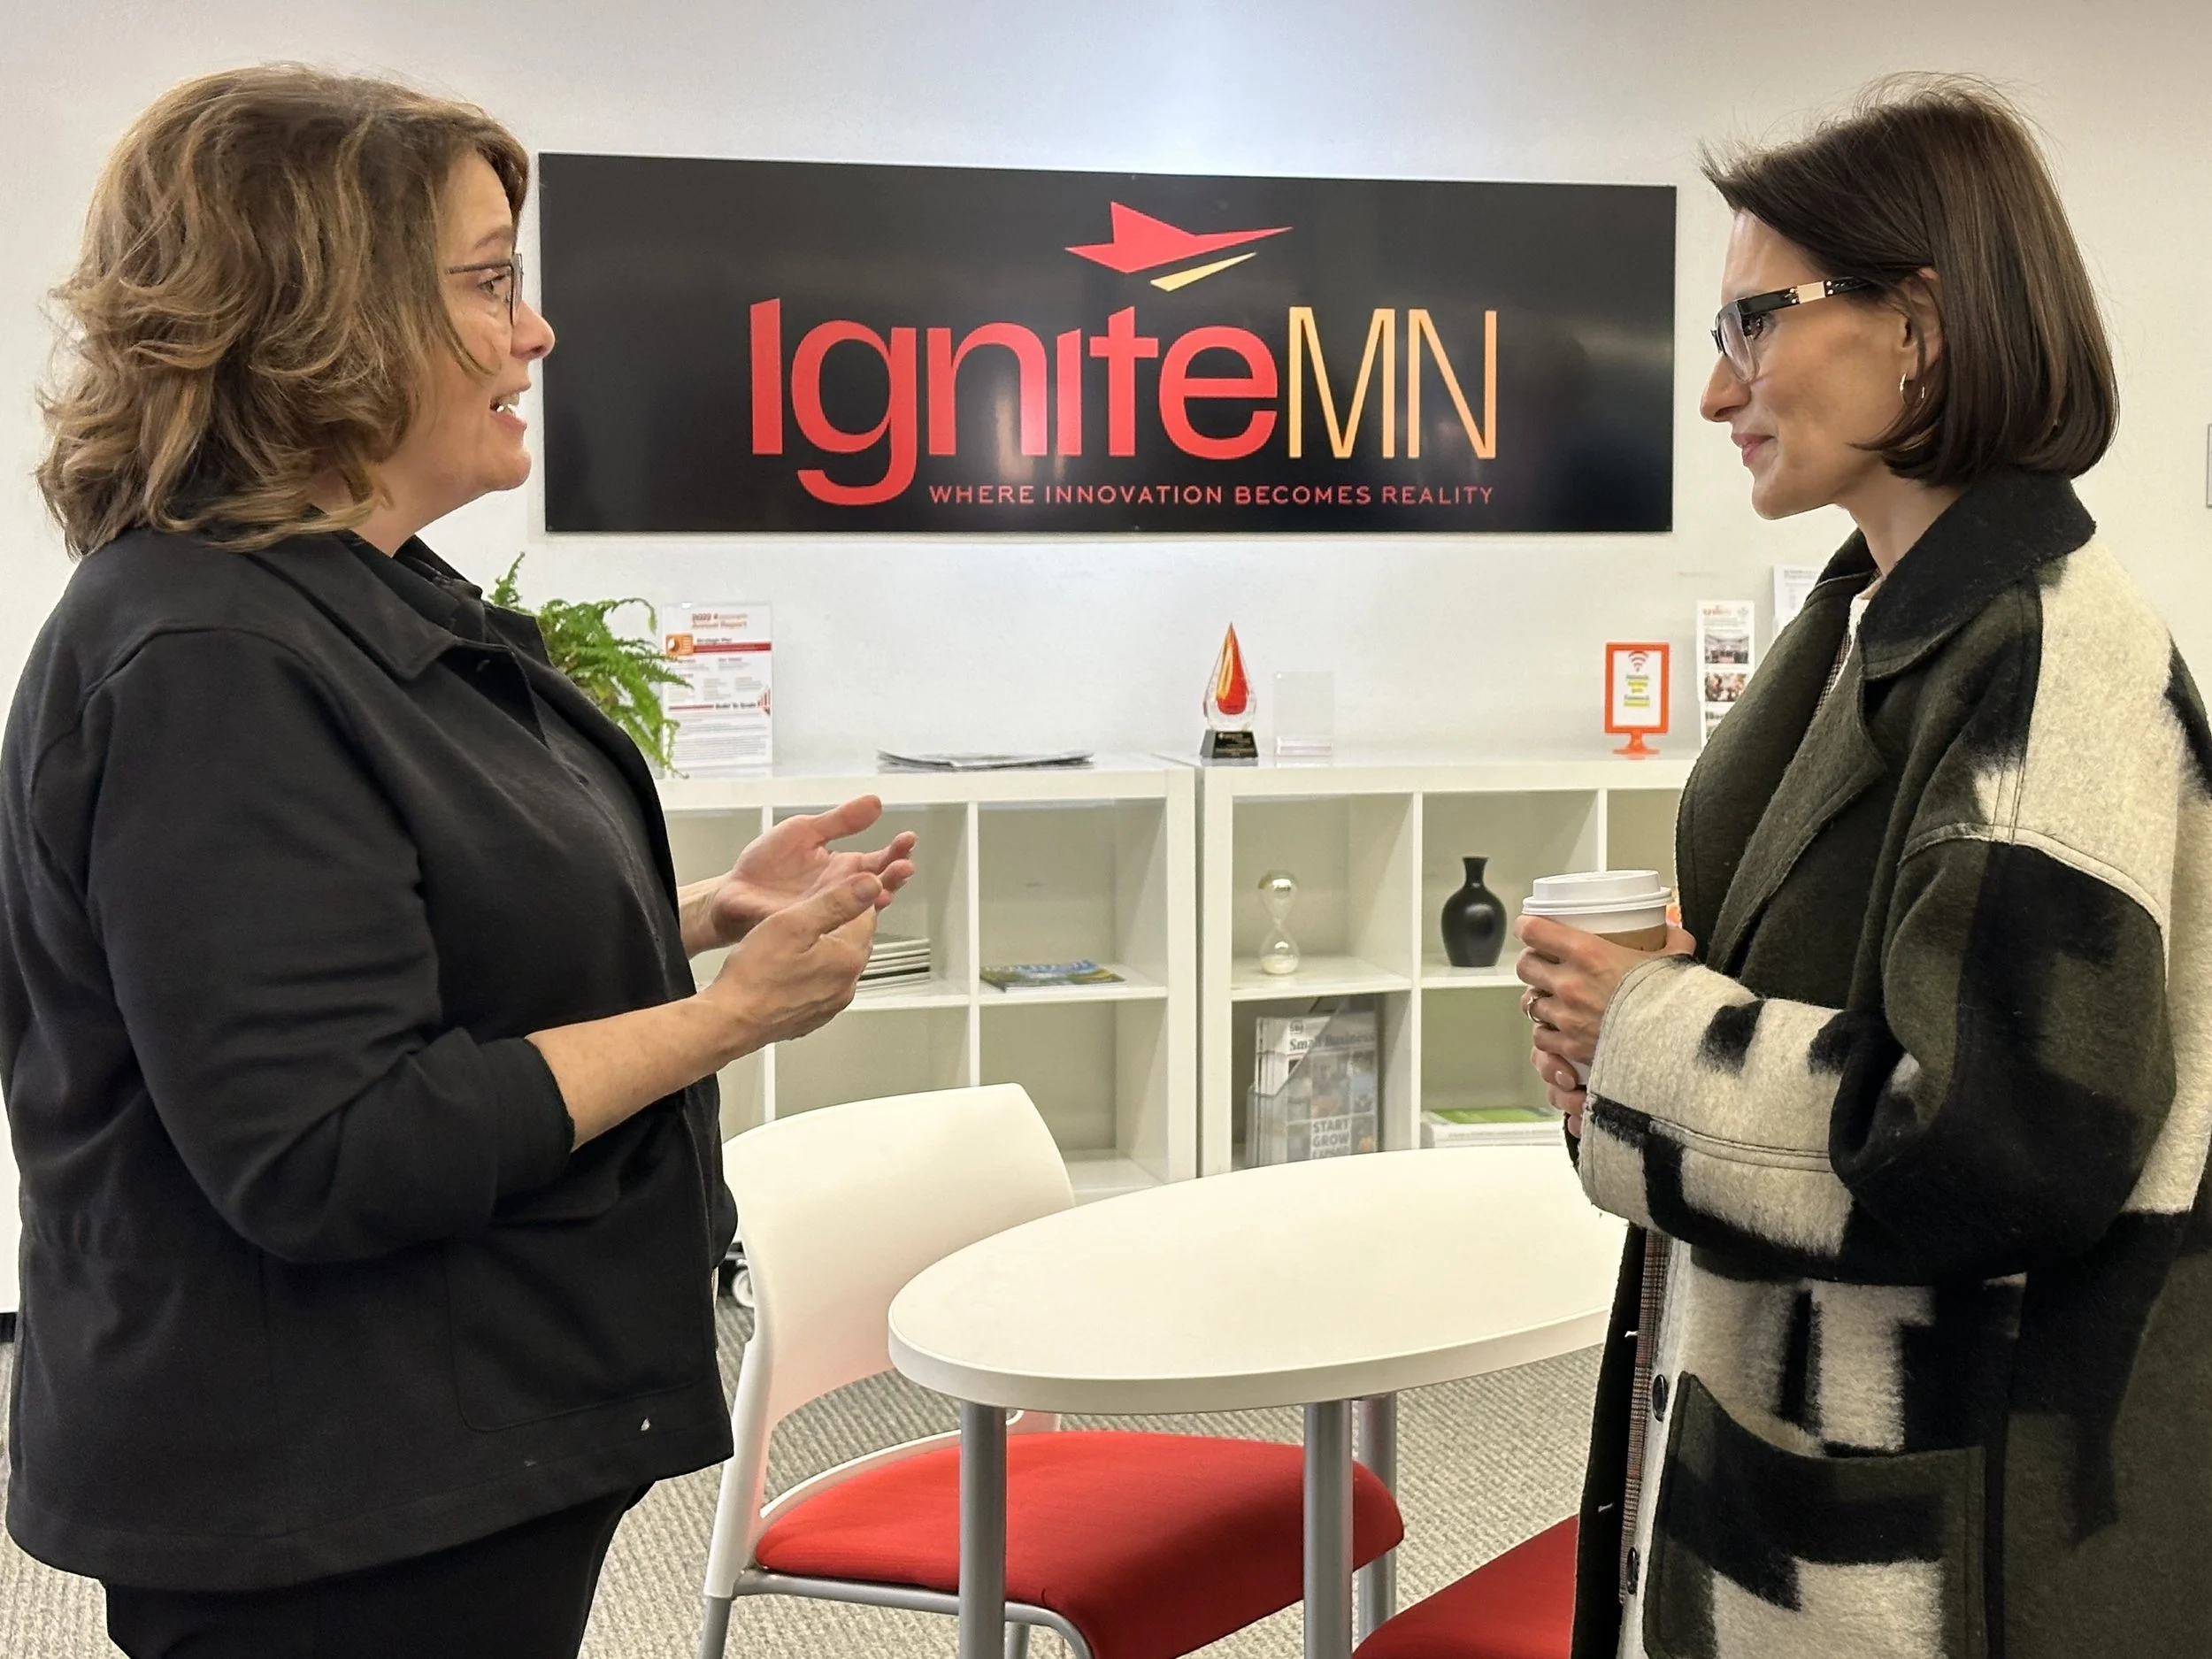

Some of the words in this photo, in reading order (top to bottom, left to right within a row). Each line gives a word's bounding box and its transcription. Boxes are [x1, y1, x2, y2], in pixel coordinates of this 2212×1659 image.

[929, 485, 1034, 504] WHERE
[1045, 484, 1223, 505] INNOVATION
[1234, 484, 1372, 505] BECOMES
[1381, 485, 1494, 506] REALITY
[1313, 1118, 1349, 1133] START
[1313, 1132, 1349, 1148] GROW
